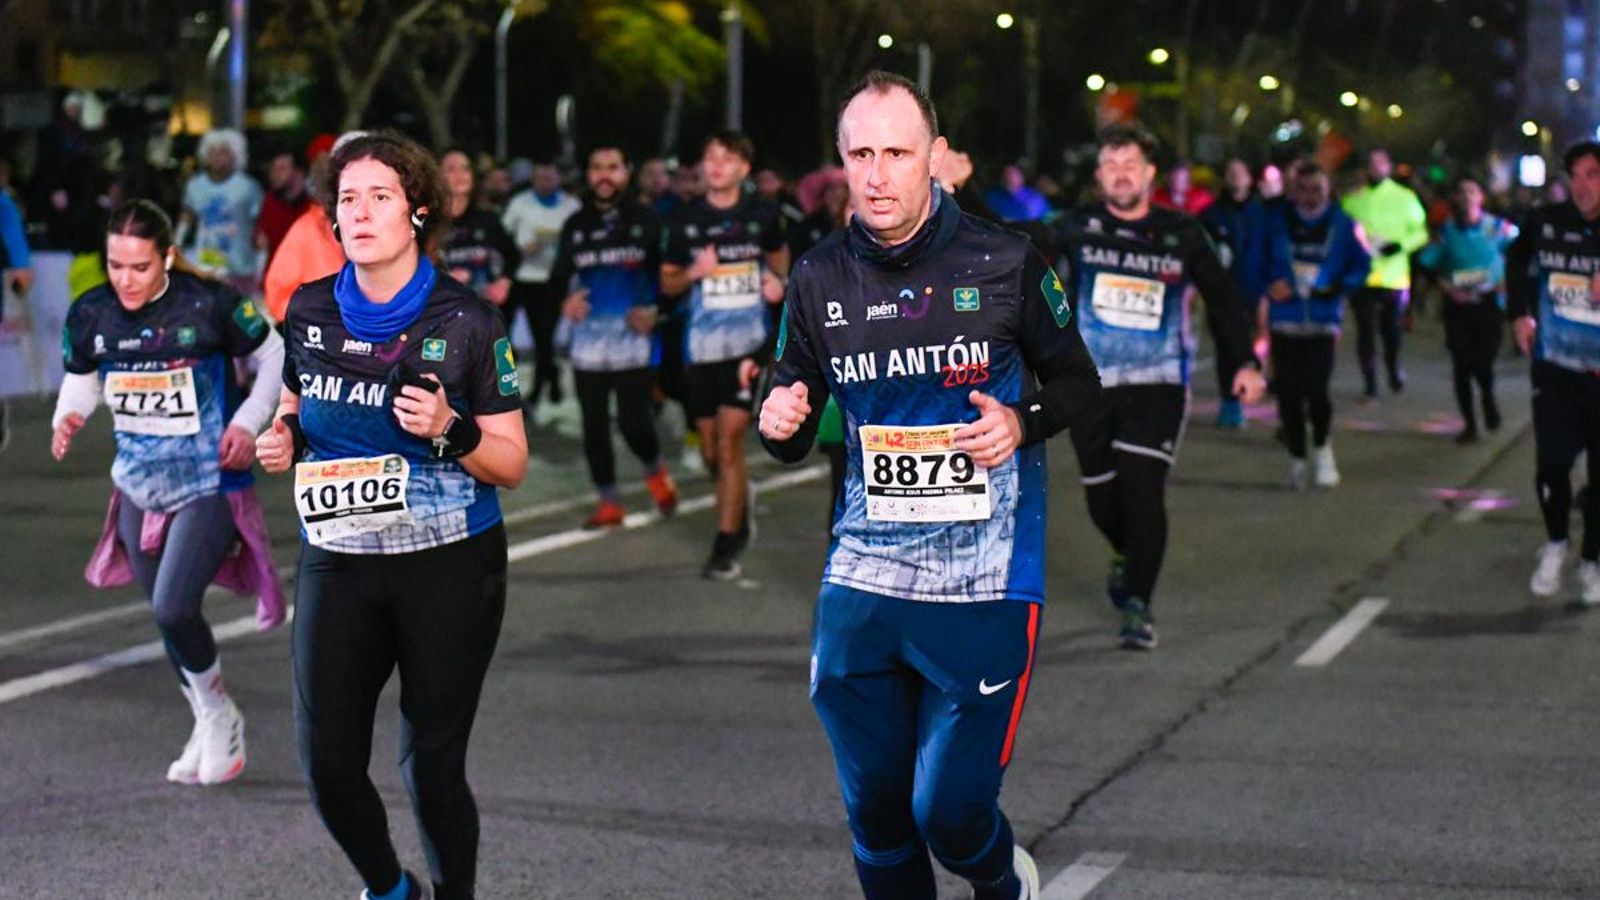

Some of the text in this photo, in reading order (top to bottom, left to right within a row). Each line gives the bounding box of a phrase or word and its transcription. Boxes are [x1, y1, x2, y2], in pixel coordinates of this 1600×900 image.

[1082, 246, 1119, 267] SAN
[831, 335, 989, 384] SAN ANTÓN
[942, 360, 990, 388] 2025
[113, 391, 183, 411] 7721
[299, 373, 387, 407] SAN AN
[885, 431, 905, 448] 42
[321, 464, 340, 478] 42
[873, 453, 974, 485] 8879
[300, 477, 402, 512] 10106
